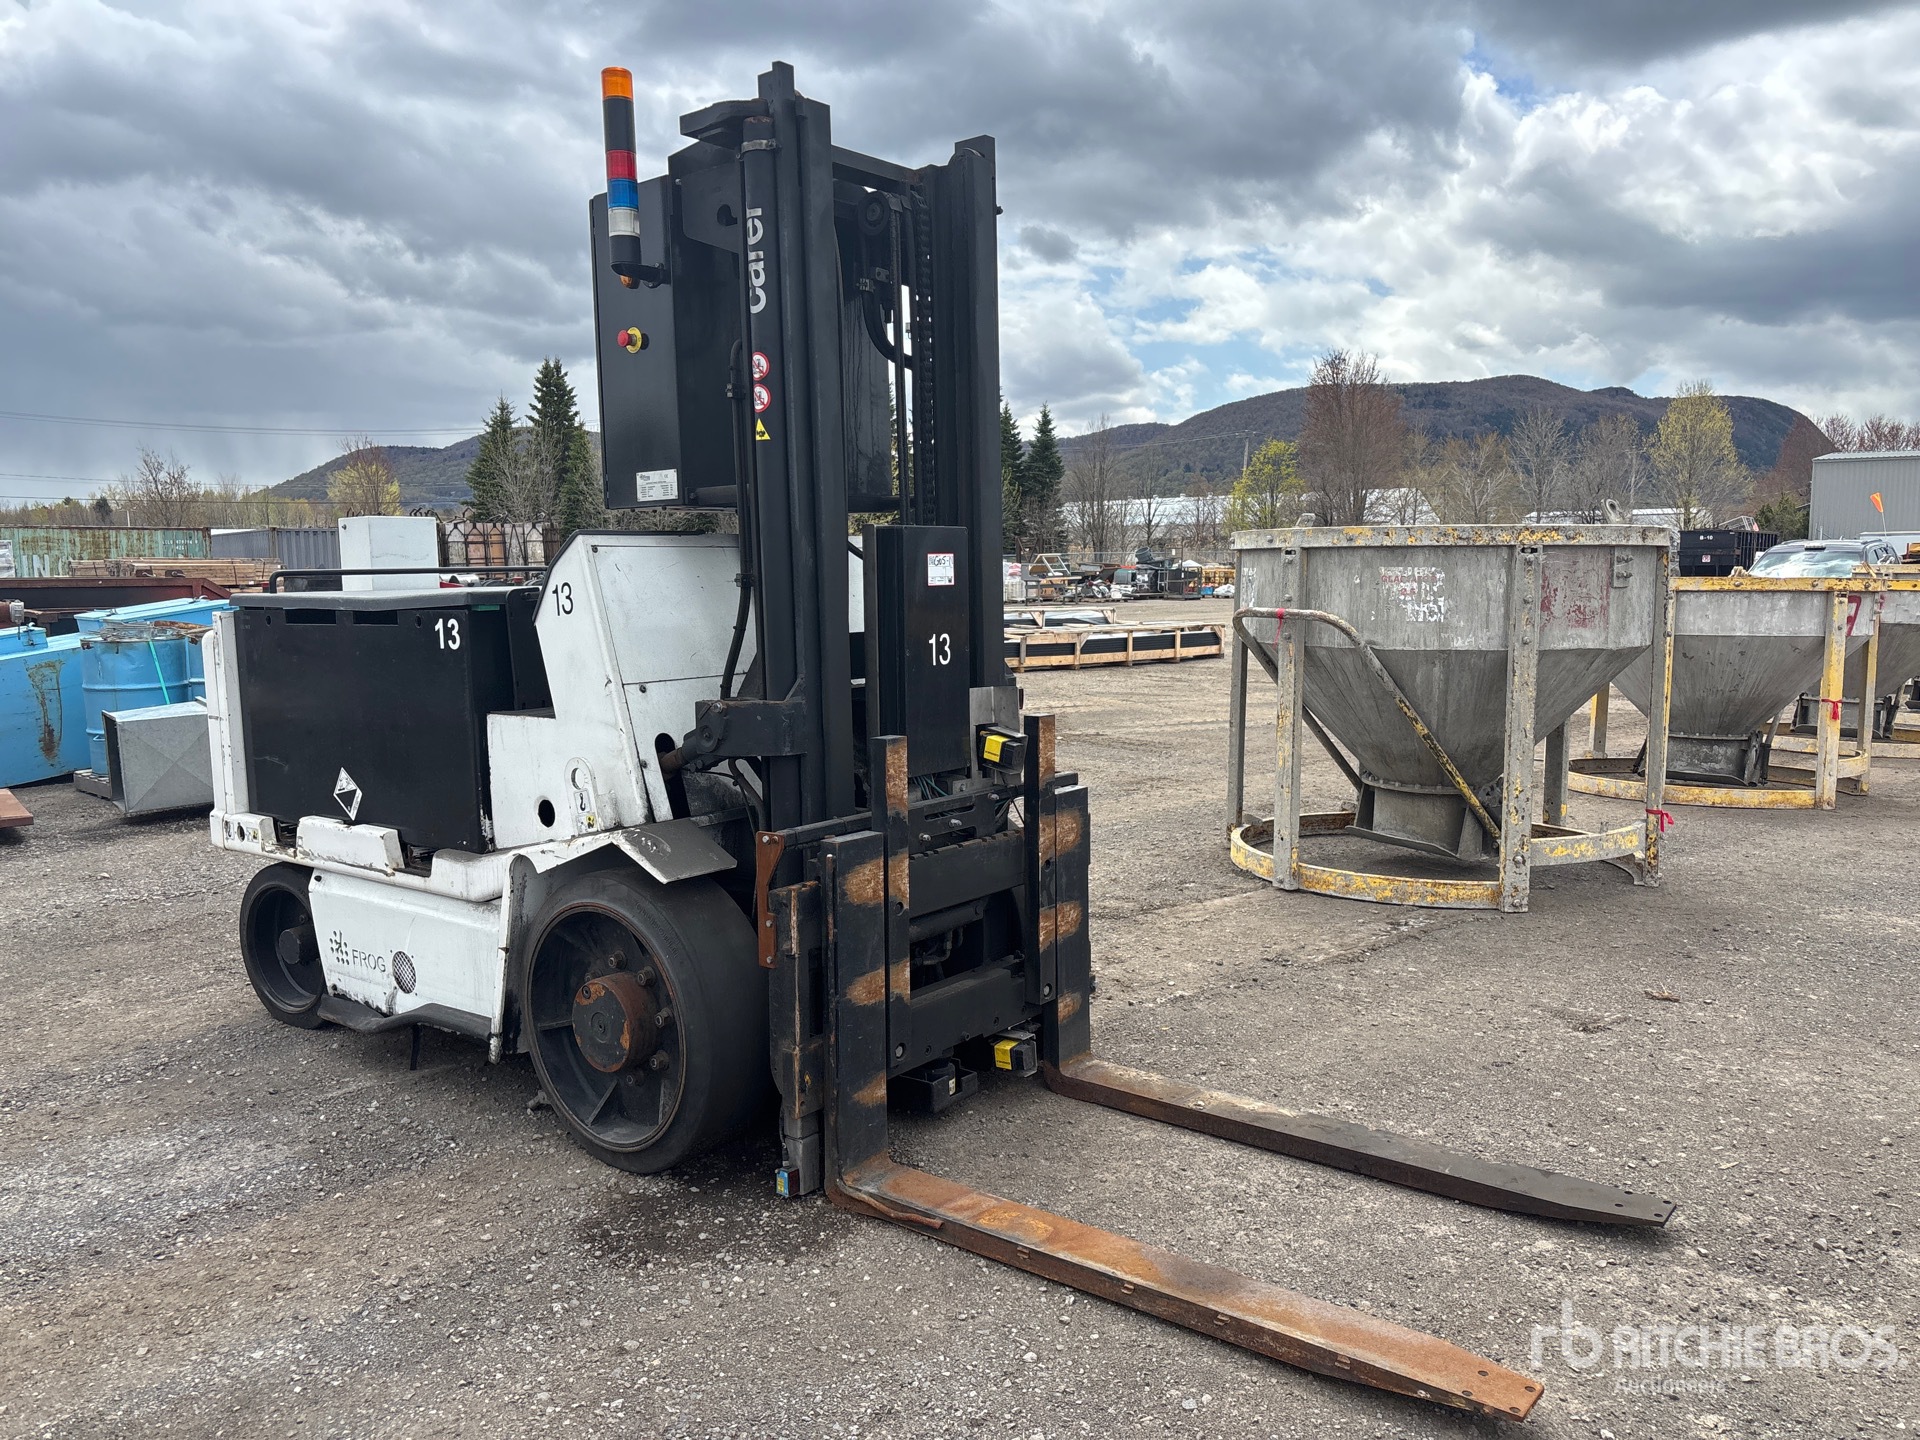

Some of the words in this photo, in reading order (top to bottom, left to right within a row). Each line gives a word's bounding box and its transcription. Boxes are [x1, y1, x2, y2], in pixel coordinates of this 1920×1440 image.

[551, 582, 574, 617] 13
[434, 618, 461, 650] 13
[928, 633, 951, 666] 13
[352, 949, 386, 973] FROG
